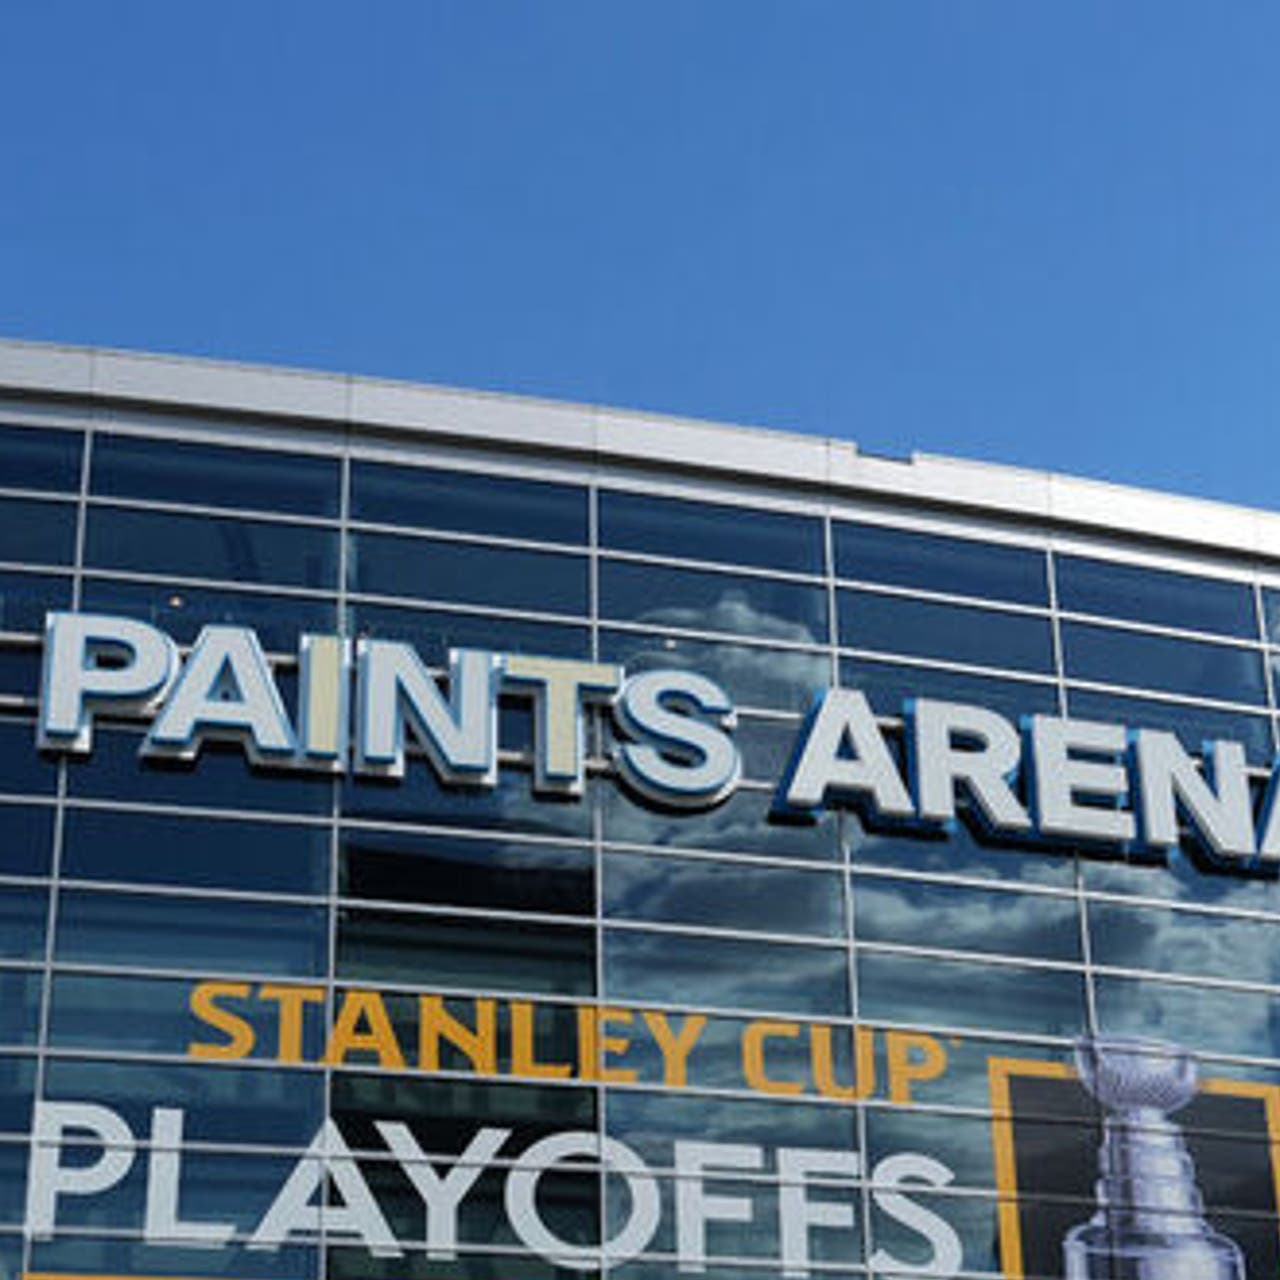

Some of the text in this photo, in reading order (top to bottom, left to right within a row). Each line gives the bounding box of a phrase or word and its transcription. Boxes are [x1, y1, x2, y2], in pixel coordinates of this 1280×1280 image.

[38, 611, 741, 806] PAINTS
[186, 980, 948, 1106] STANLEY CUP
